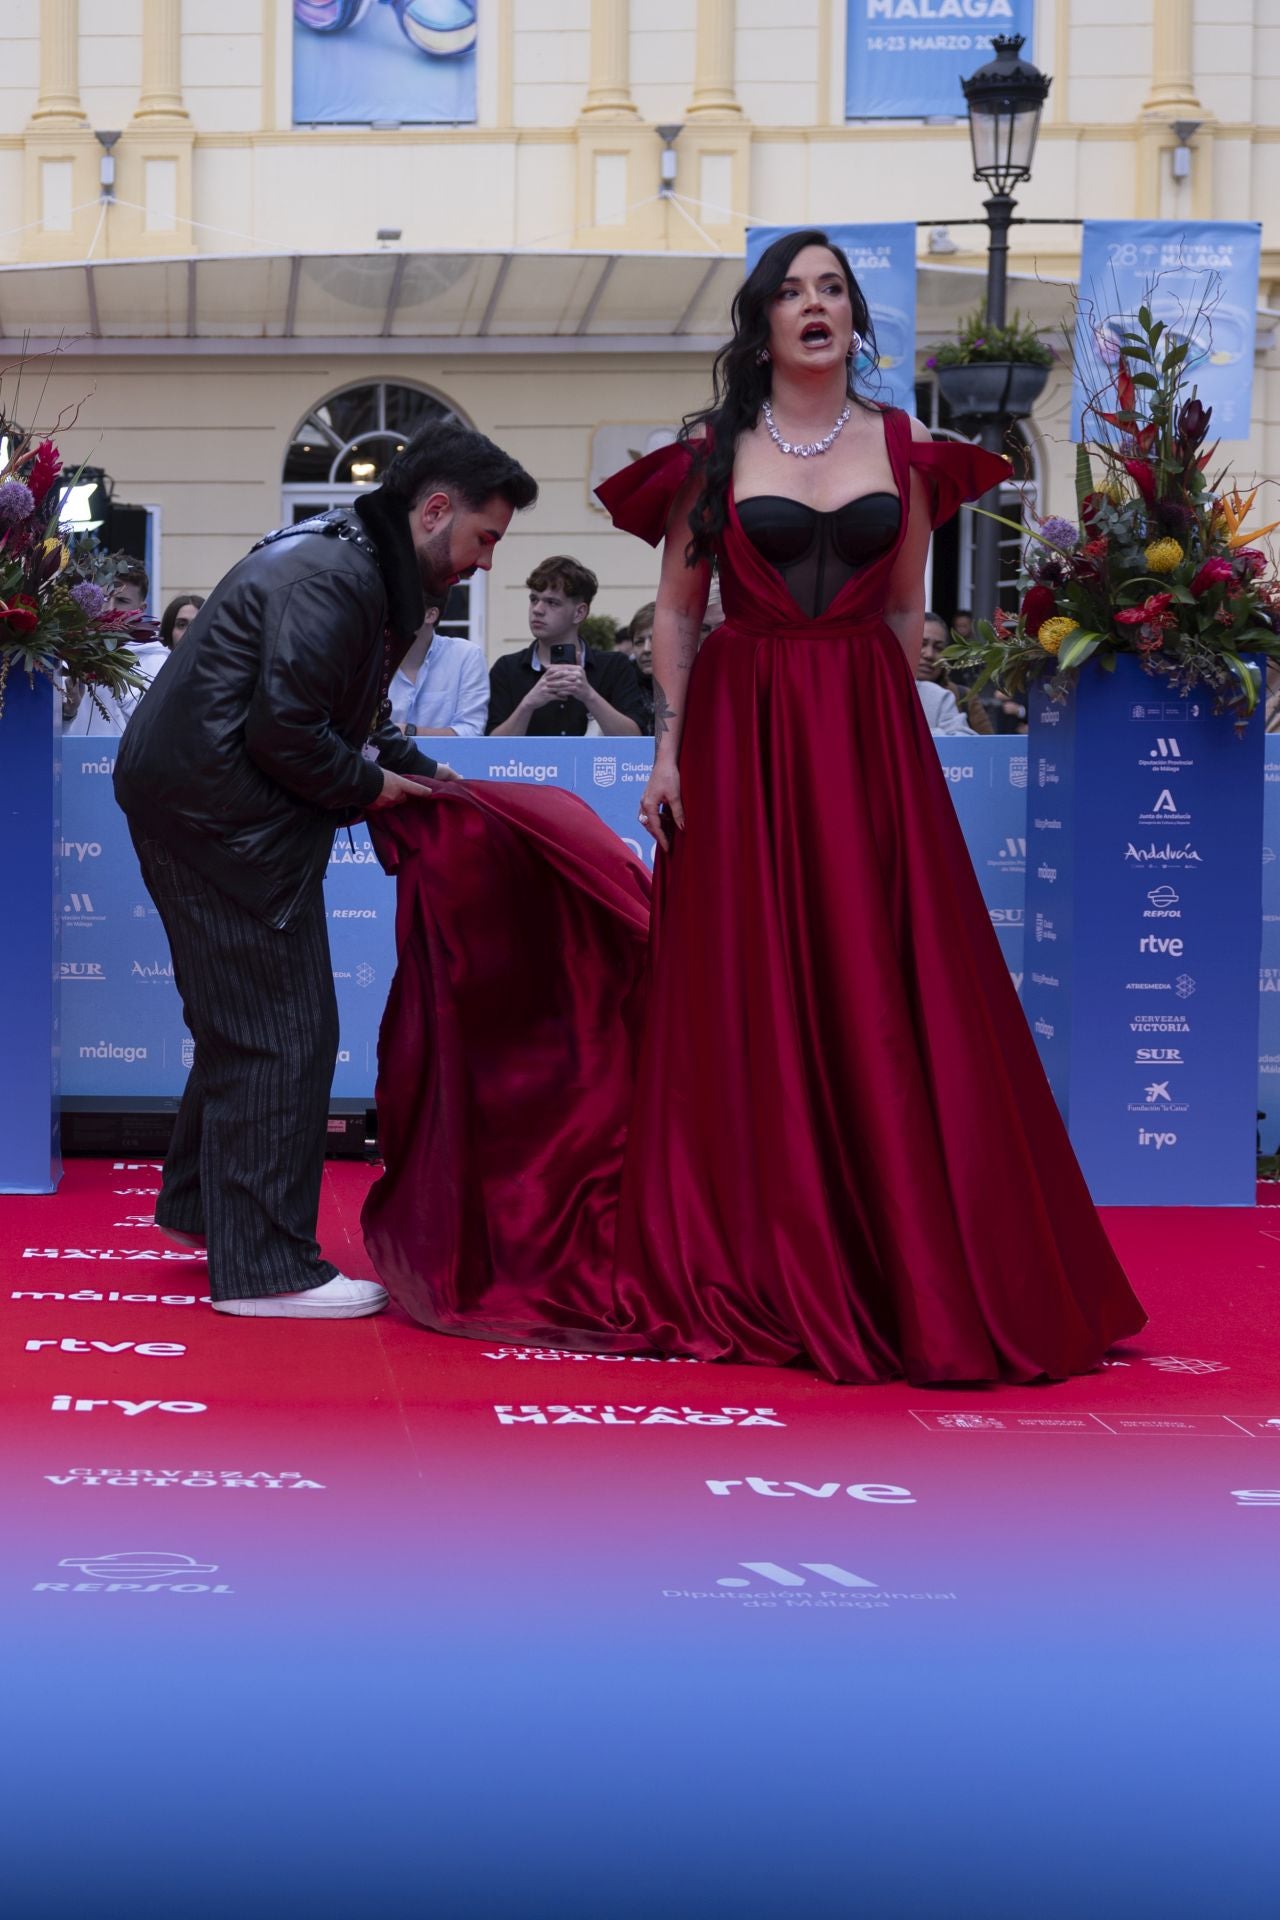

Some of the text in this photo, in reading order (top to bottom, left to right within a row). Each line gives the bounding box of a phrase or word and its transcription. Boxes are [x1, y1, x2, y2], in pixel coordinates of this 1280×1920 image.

[867, 36, 906, 50] 14-23
[909, 36, 972, 50] MARZO
[1107, 243, 1137, 266] 28
[333, 910, 377, 918] REPSOL
[1143, 910, 1181, 918] REPSOL
[1140, 934, 1183, 957] rtve
[1129, 1023, 1190, 1032] VICTORIA
[1136, 1048, 1181, 1060] SUR
[1139, 1127, 1177, 1150] iryo
[25, 1337, 187, 1357] rtve
[51, 1395, 208, 1416] iryo
[494, 1405, 777, 1415] FESTIVAL DE
[69, 1468, 302, 1479] CERVEZAS
[44, 1475, 326, 1488] VICTORIA
[705, 1477, 917, 1504] rtve
[32, 1582, 236, 1594] REPSOL
[662, 1589, 958, 1601] Diputación Provincial
[743, 1599, 890, 1609] de Málaga
